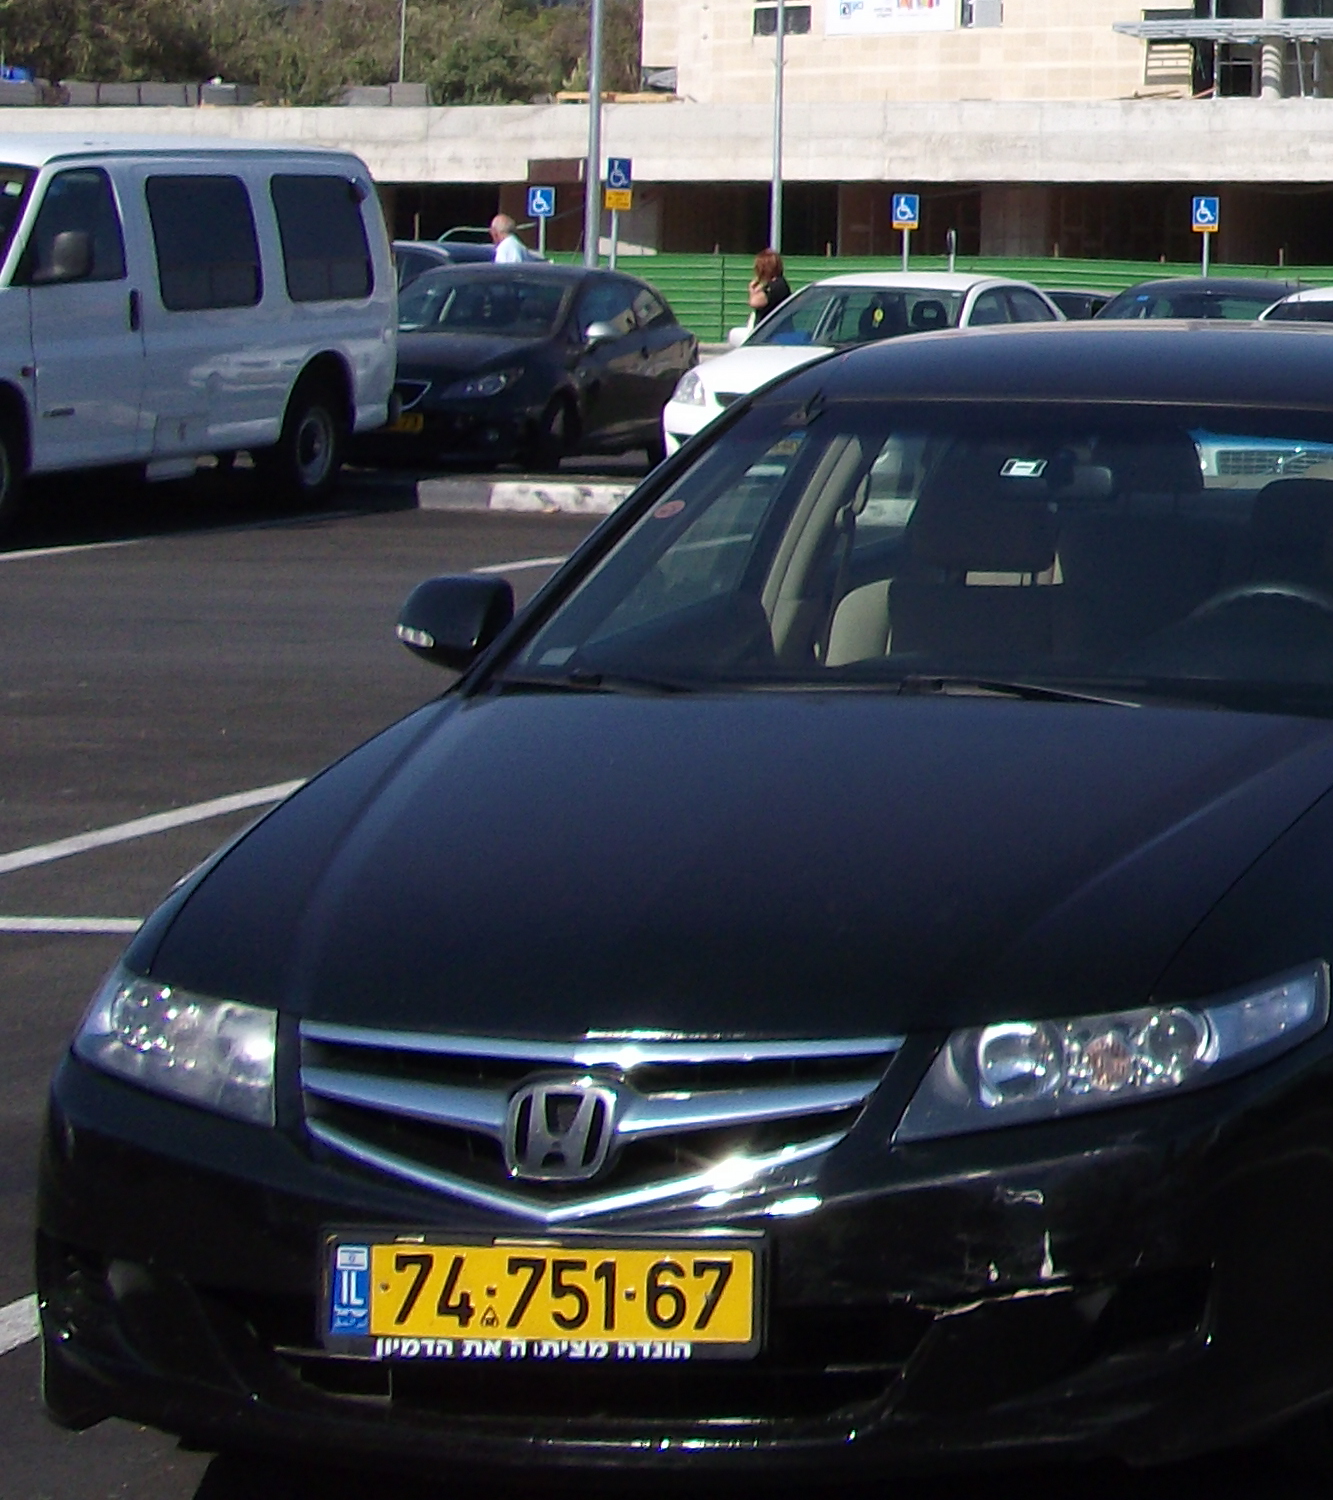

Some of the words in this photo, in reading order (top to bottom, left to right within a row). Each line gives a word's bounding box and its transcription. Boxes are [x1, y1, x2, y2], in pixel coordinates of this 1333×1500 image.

[341, 1270, 365, 1306] IL
[375, 1337, 454, 1361] הדמיון
[462, 1338, 502, 1358] את
[616, 1340, 692, 1360] הונדה
